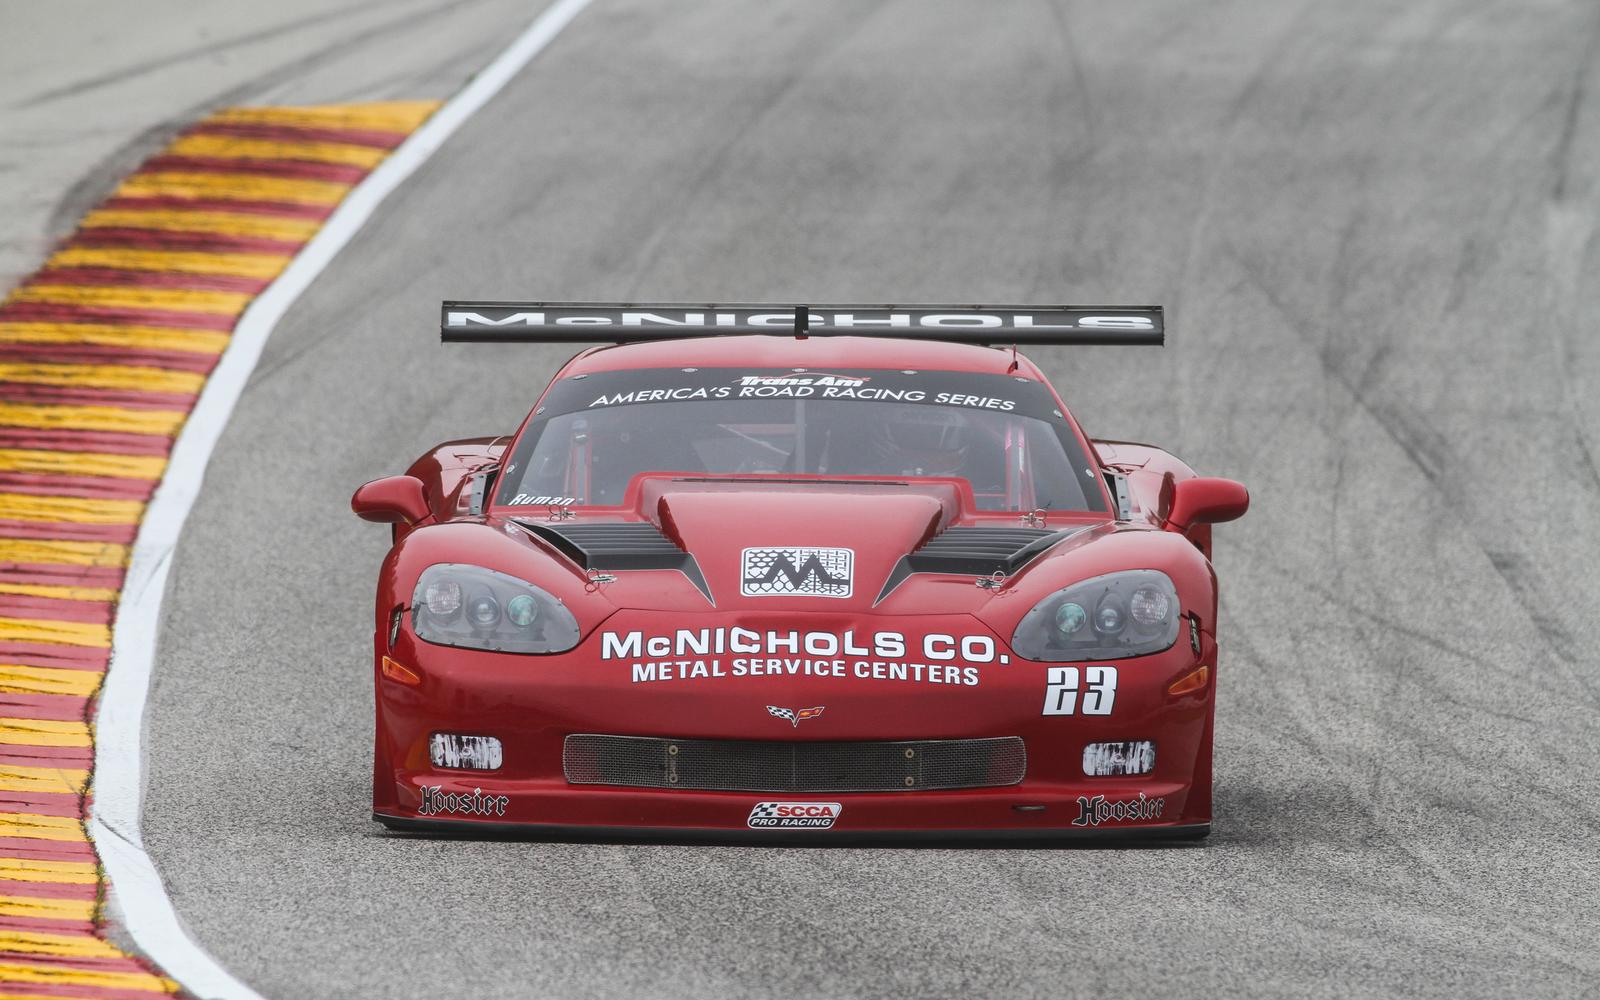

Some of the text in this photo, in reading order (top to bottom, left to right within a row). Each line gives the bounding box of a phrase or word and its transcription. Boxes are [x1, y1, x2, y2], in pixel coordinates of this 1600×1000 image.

[447, 312, 1155, 330] McNICHOLS
[739, 376, 864, 387] Trans Am
[589, 386, 1015, 411] AMERICA'S ROAD RACING SERIES
[508, 494, 575, 506] Ruman
[601, 627, 1011, 665] McNICHOLS CO.
[632, 658, 979, 686] METAL SERVICE CENTERS
[1041, 666, 1119, 717] 23
[418, 785, 509, 816] Hoosier
[776, 806, 834, 817] SCCA
[1071, 792, 1165, 827] Hoosier
[751, 818, 832, 827] PRO RACING
